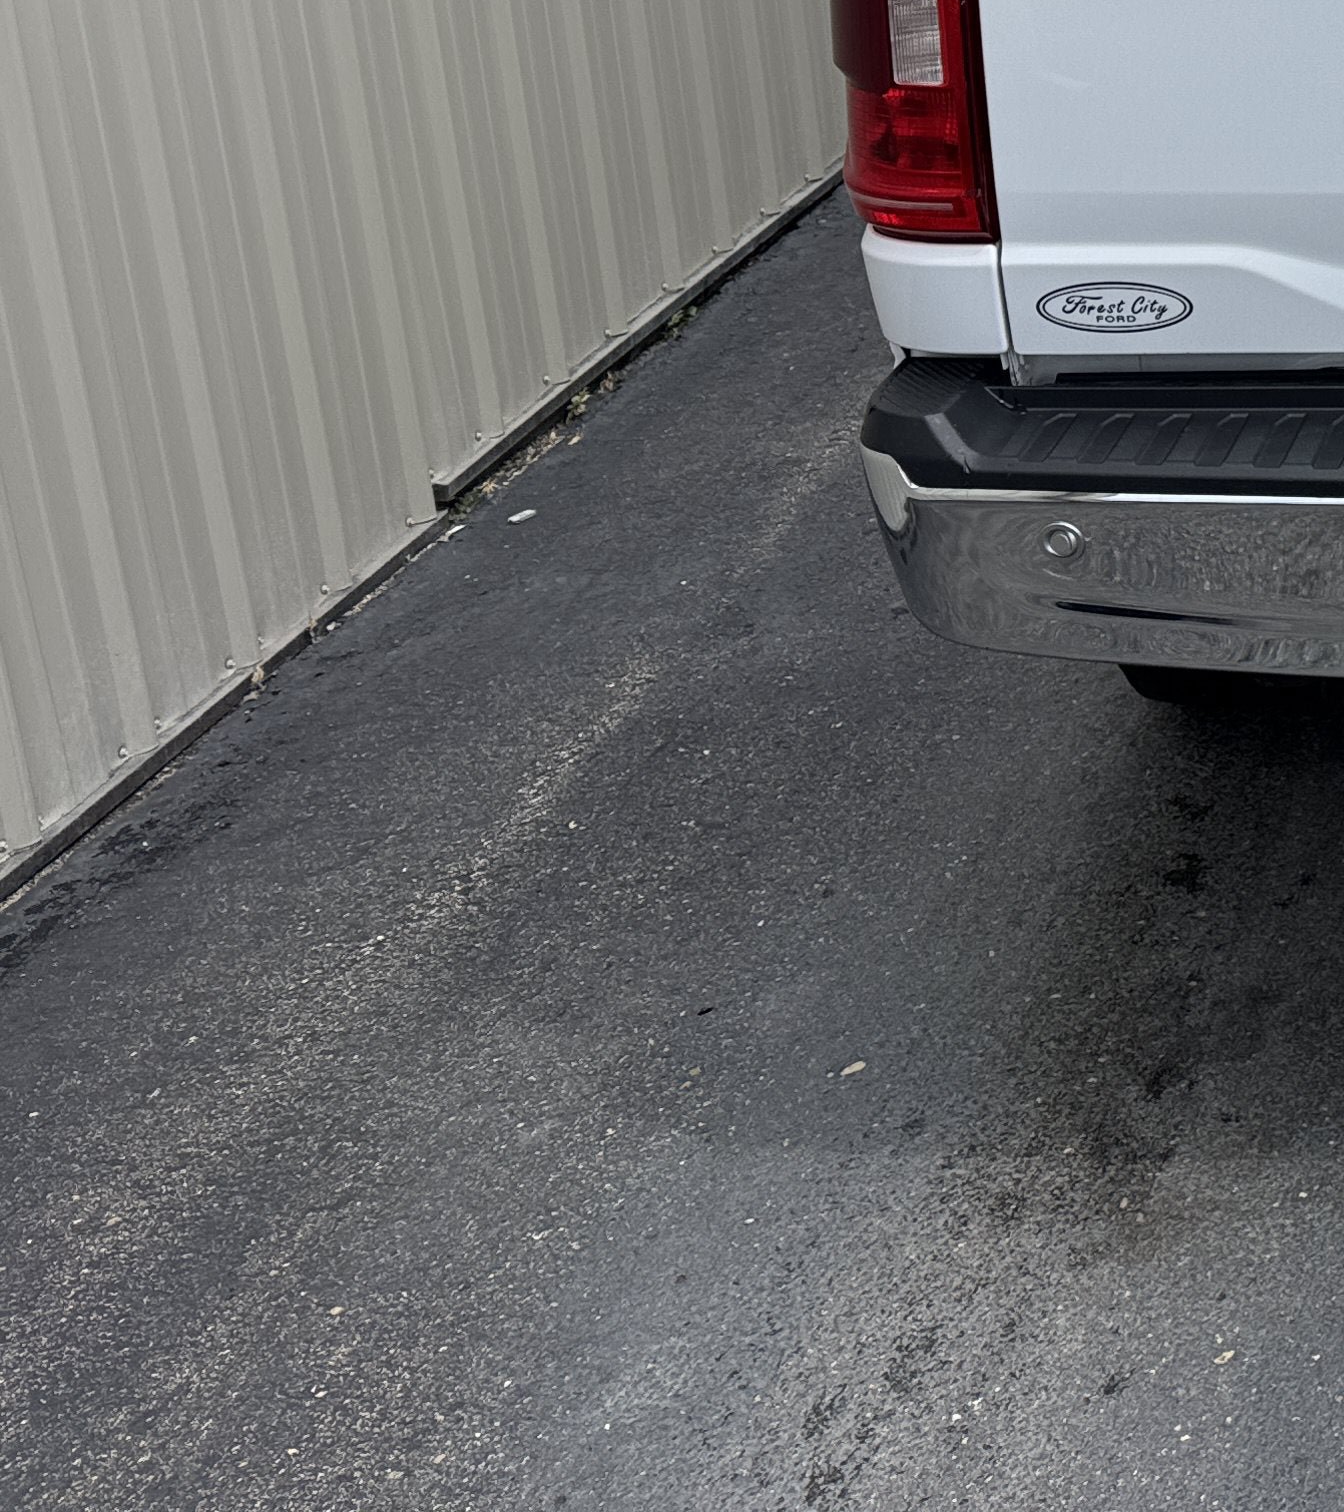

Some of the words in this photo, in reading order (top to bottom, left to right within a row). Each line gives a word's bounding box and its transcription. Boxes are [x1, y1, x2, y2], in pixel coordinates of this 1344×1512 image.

[1062, 295, 1125, 315] Forest
[1131, 295, 1168, 320] City
[1096, 315, 1136, 323] FORD
